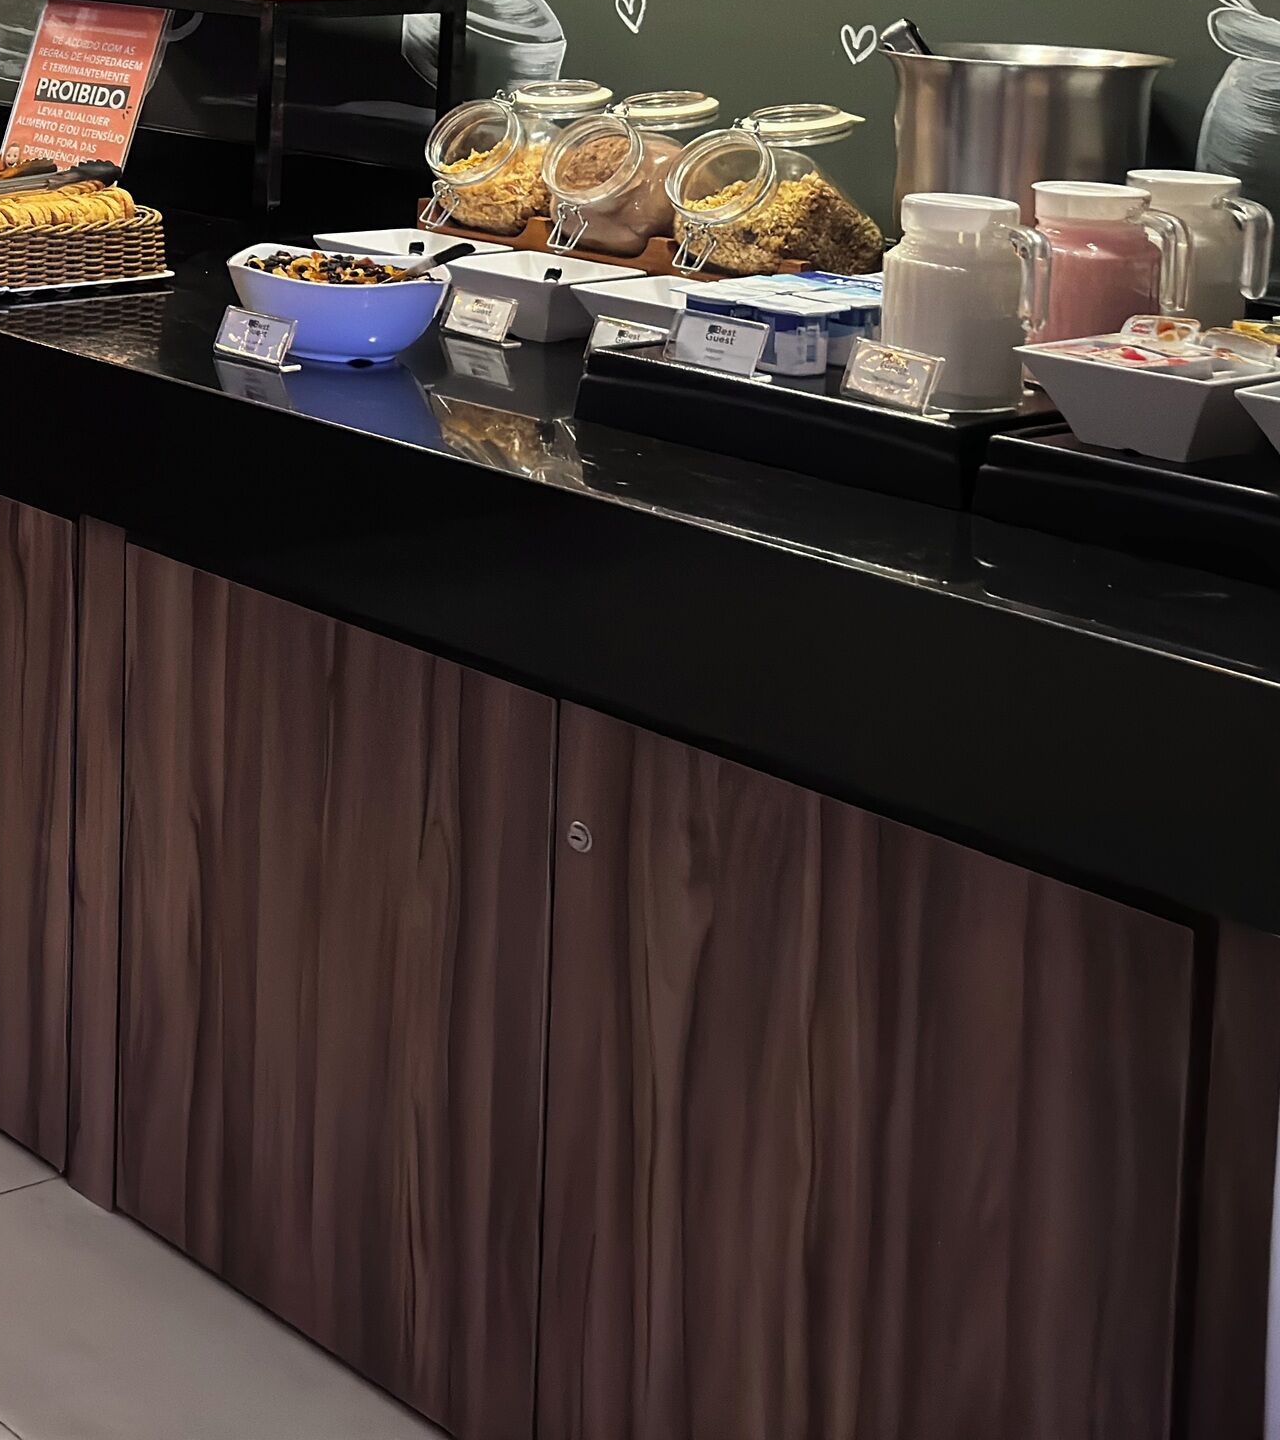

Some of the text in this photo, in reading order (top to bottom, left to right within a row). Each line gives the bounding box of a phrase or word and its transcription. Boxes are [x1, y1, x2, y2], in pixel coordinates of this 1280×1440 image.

[39, 47, 144, 71] REGRAS DE HOSPEDAGEM
[49, 62, 130, 83] TERMINANTEMENTE
[36, 78, 126, 109] PROIBIDO
[16, 116, 58, 132] ALIMENTO
[37, 106, 111, 127] LEVAR QUALQUER
[33, 133, 97, 154] PARA FORA DAS
[705, 333, 734, 345] Guest
